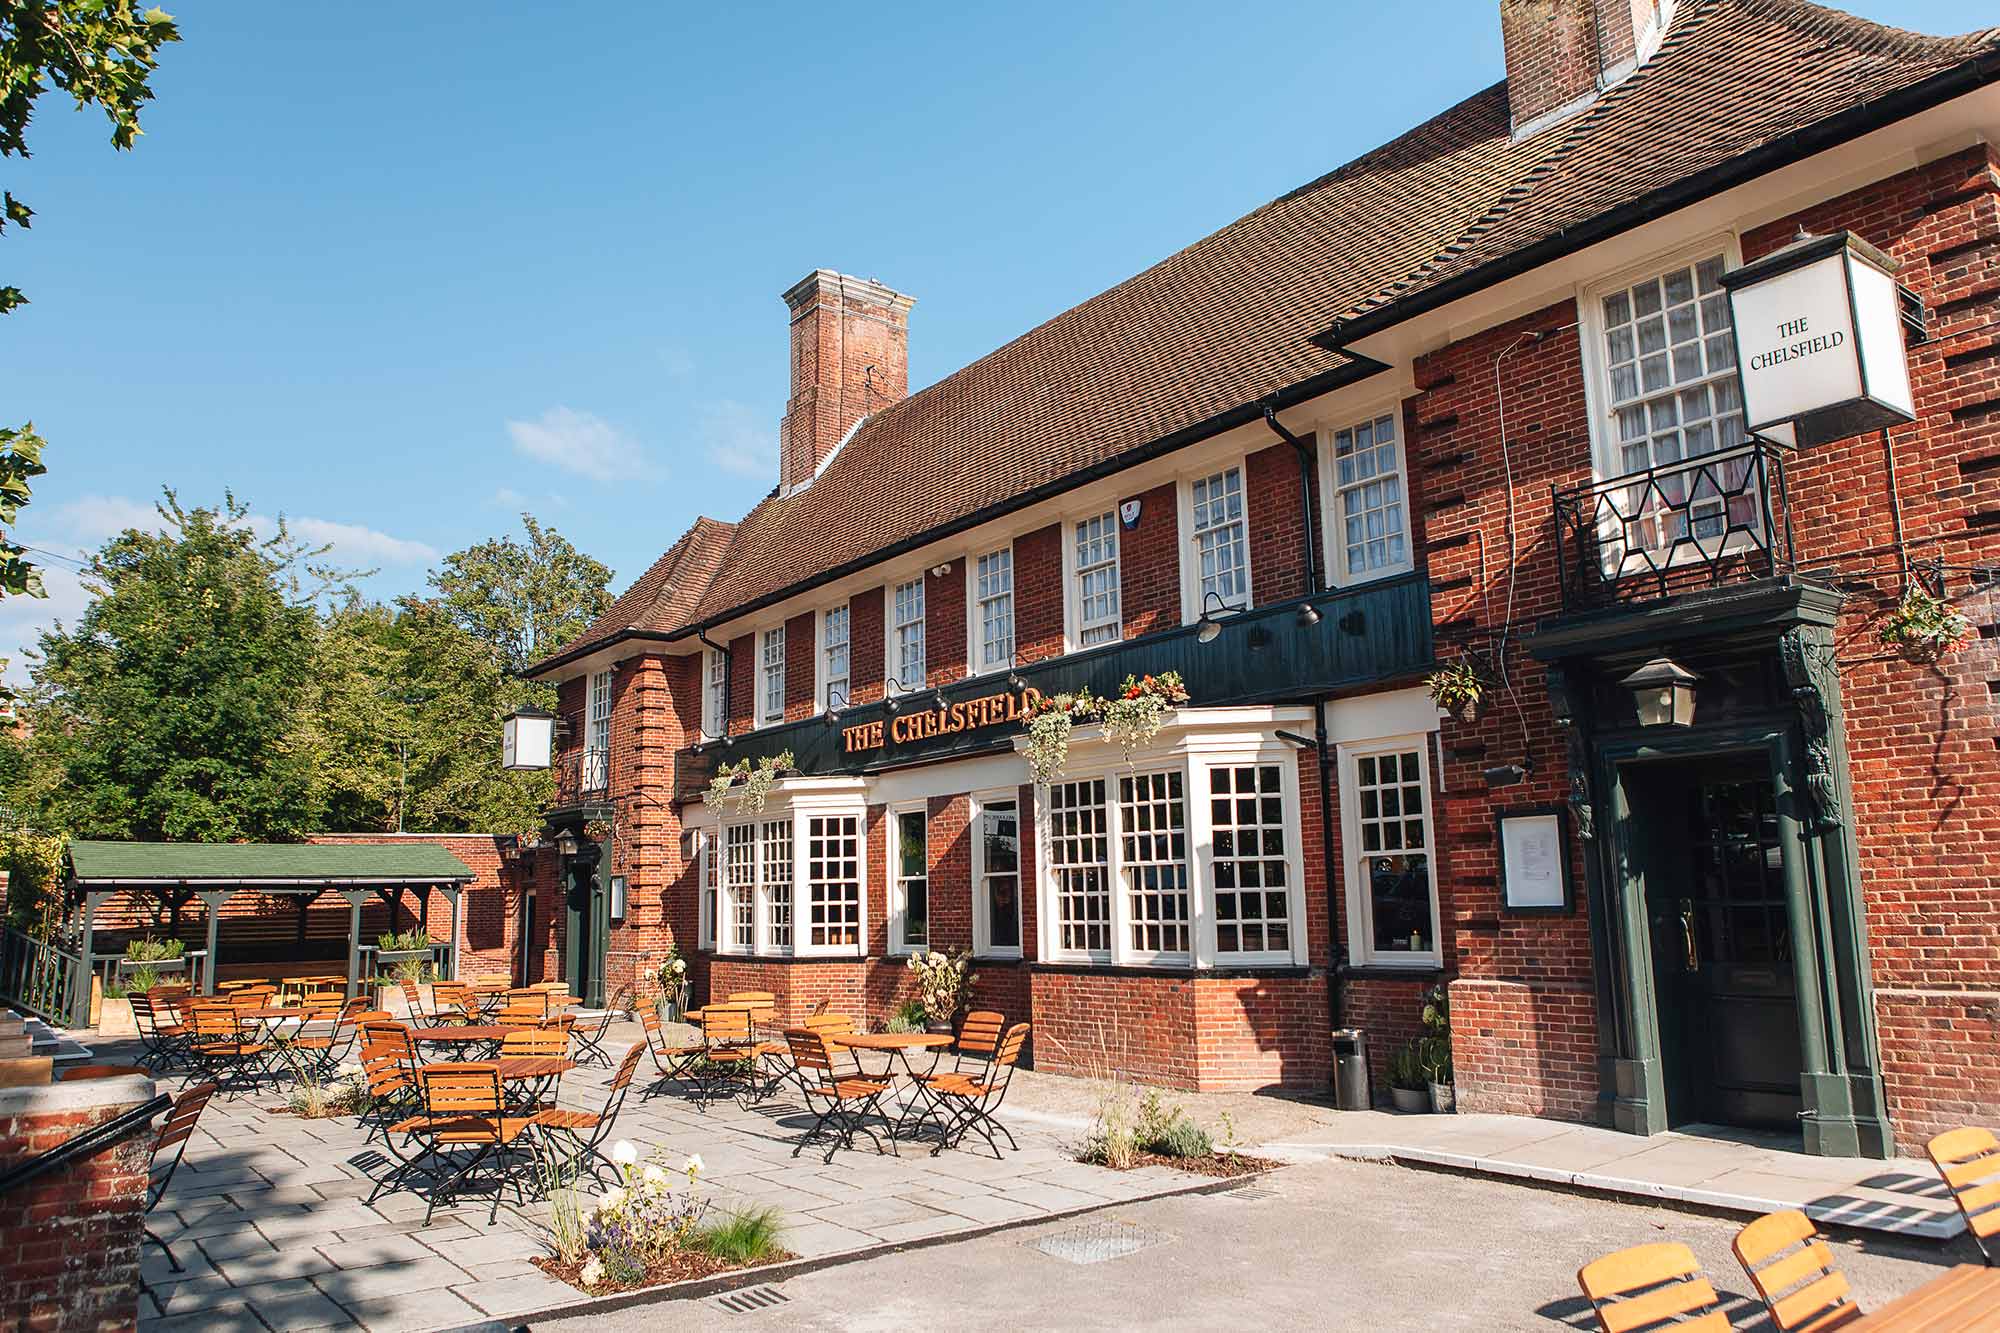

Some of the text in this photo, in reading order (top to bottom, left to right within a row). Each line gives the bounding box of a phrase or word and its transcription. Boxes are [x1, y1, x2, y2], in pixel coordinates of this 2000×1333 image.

[1777, 317, 1809, 339] THE
[1751, 331, 1844, 371] CHELSFIELD
[842, 687, 1042, 752] THE CHELSFIELD
